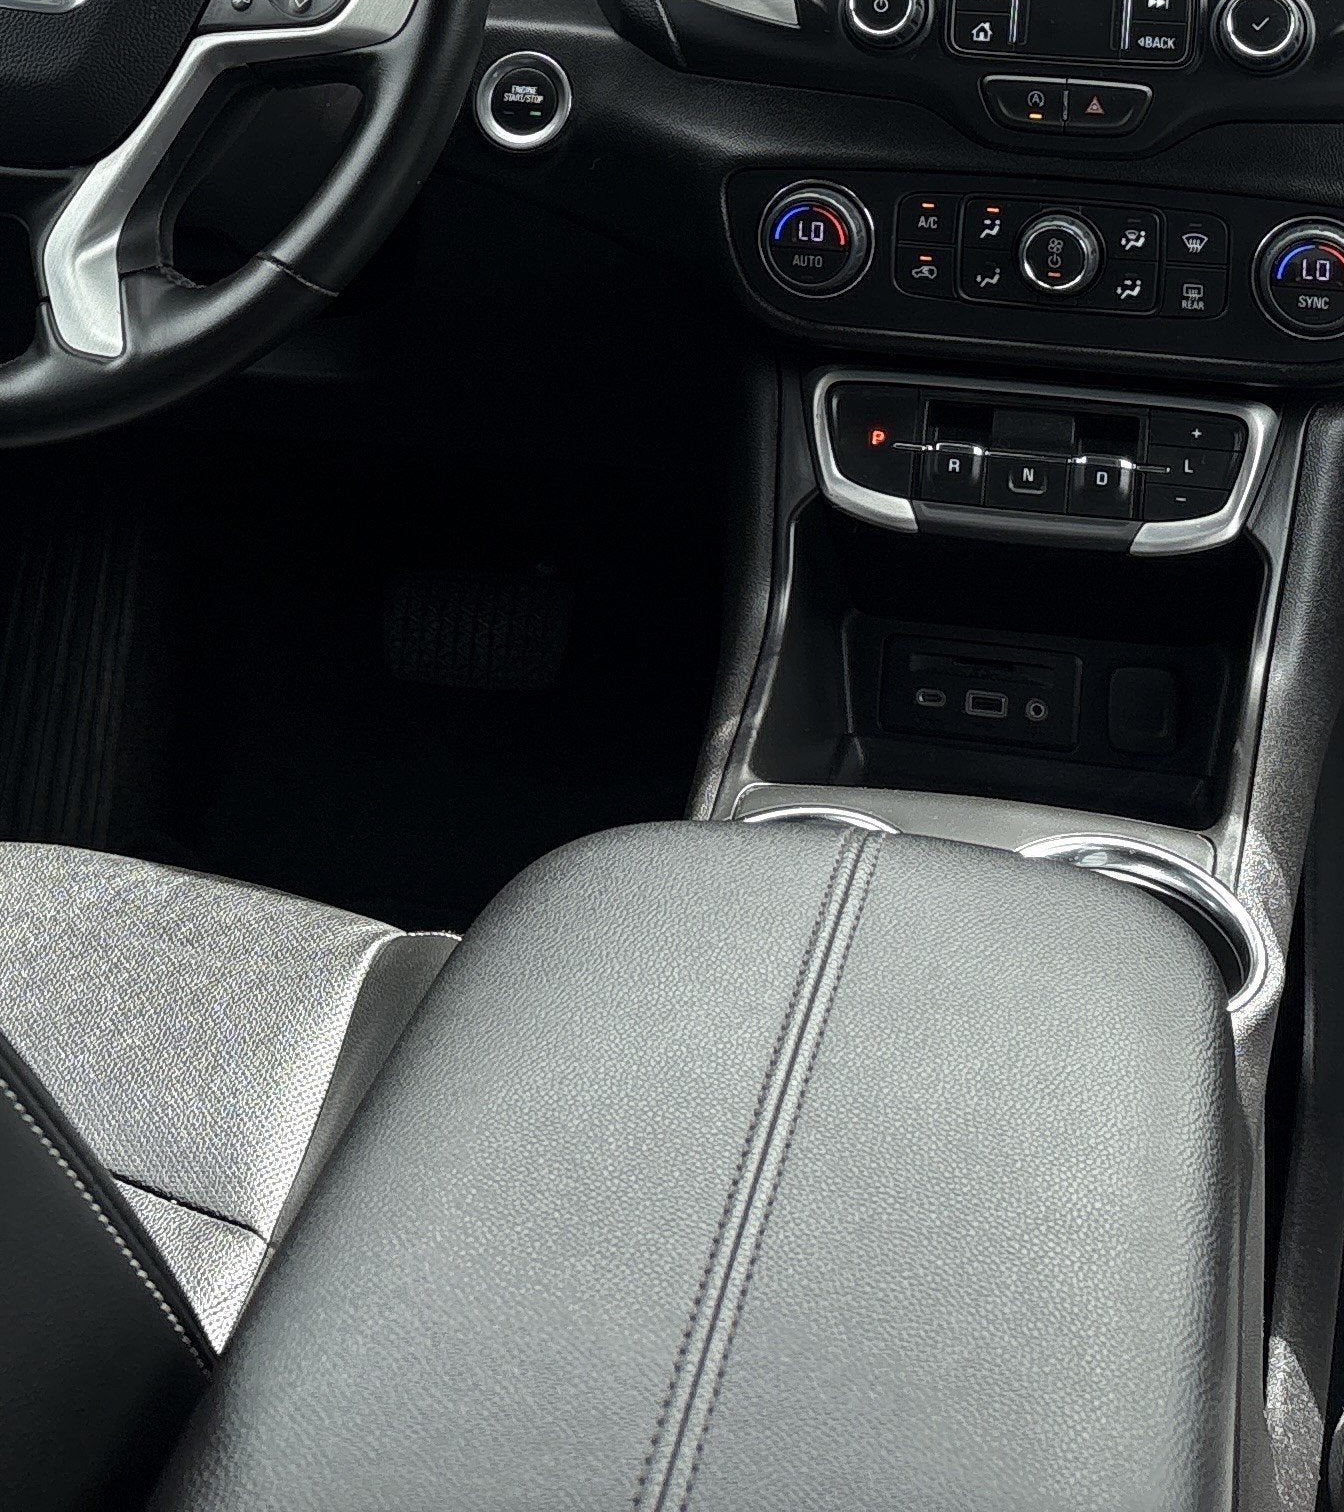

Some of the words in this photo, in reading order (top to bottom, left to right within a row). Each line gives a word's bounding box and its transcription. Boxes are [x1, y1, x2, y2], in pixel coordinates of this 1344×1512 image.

[1145, 36, 1176, 49] BACK
[917, 215, 938, 230] A/C
[792, 253, 824, 269] AUTO
[1181, 299, 1205, 311] REAR
[1297, 294, 1330, 311] SYNC
[871, 428, 885, 446] P
[948, 458, 960, 474] R
[1184, 459, 1194, 475] L
[1023, 467, 1034, 483] N
[1096, 471, 1108, 486] D
